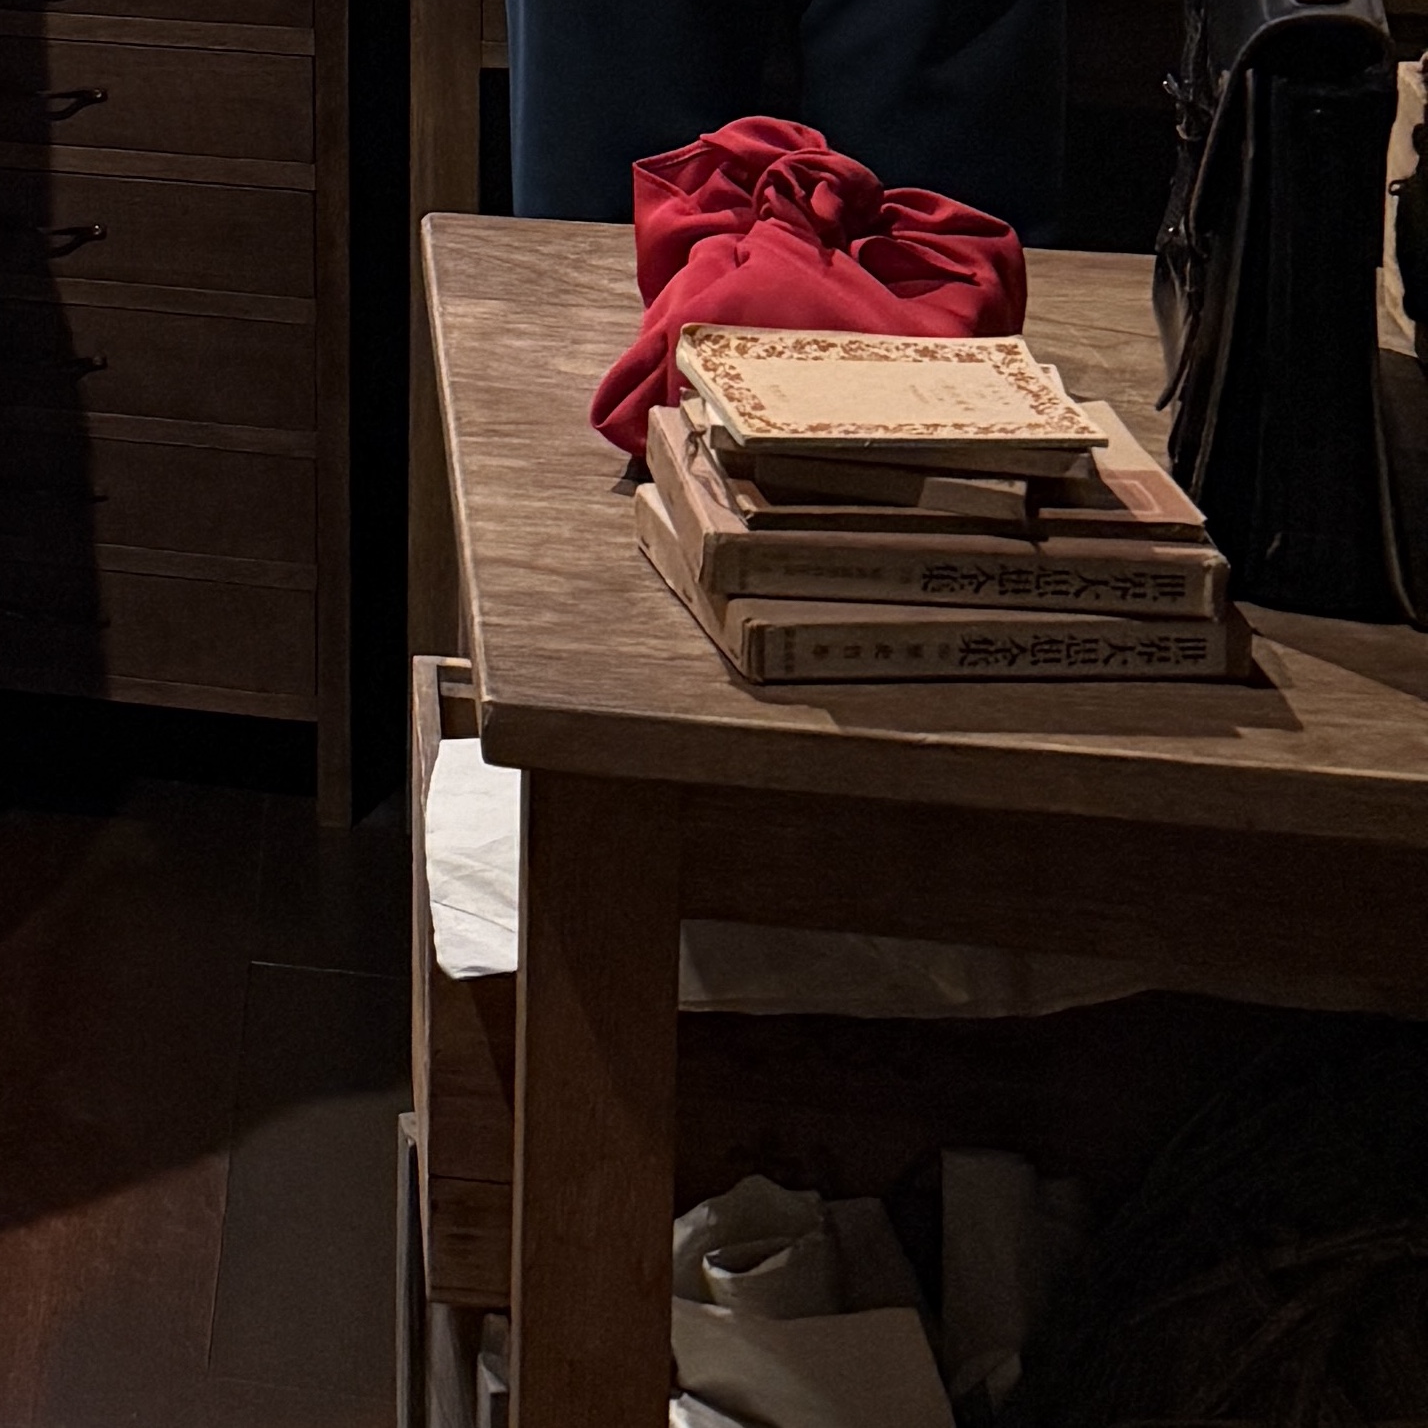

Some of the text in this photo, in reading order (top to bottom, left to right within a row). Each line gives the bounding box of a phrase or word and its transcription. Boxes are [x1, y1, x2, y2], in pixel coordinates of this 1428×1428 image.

[922, 564, 1186, 602] 世界大思想全集
[957, 636, 1208, 667] 世界大思想全集
